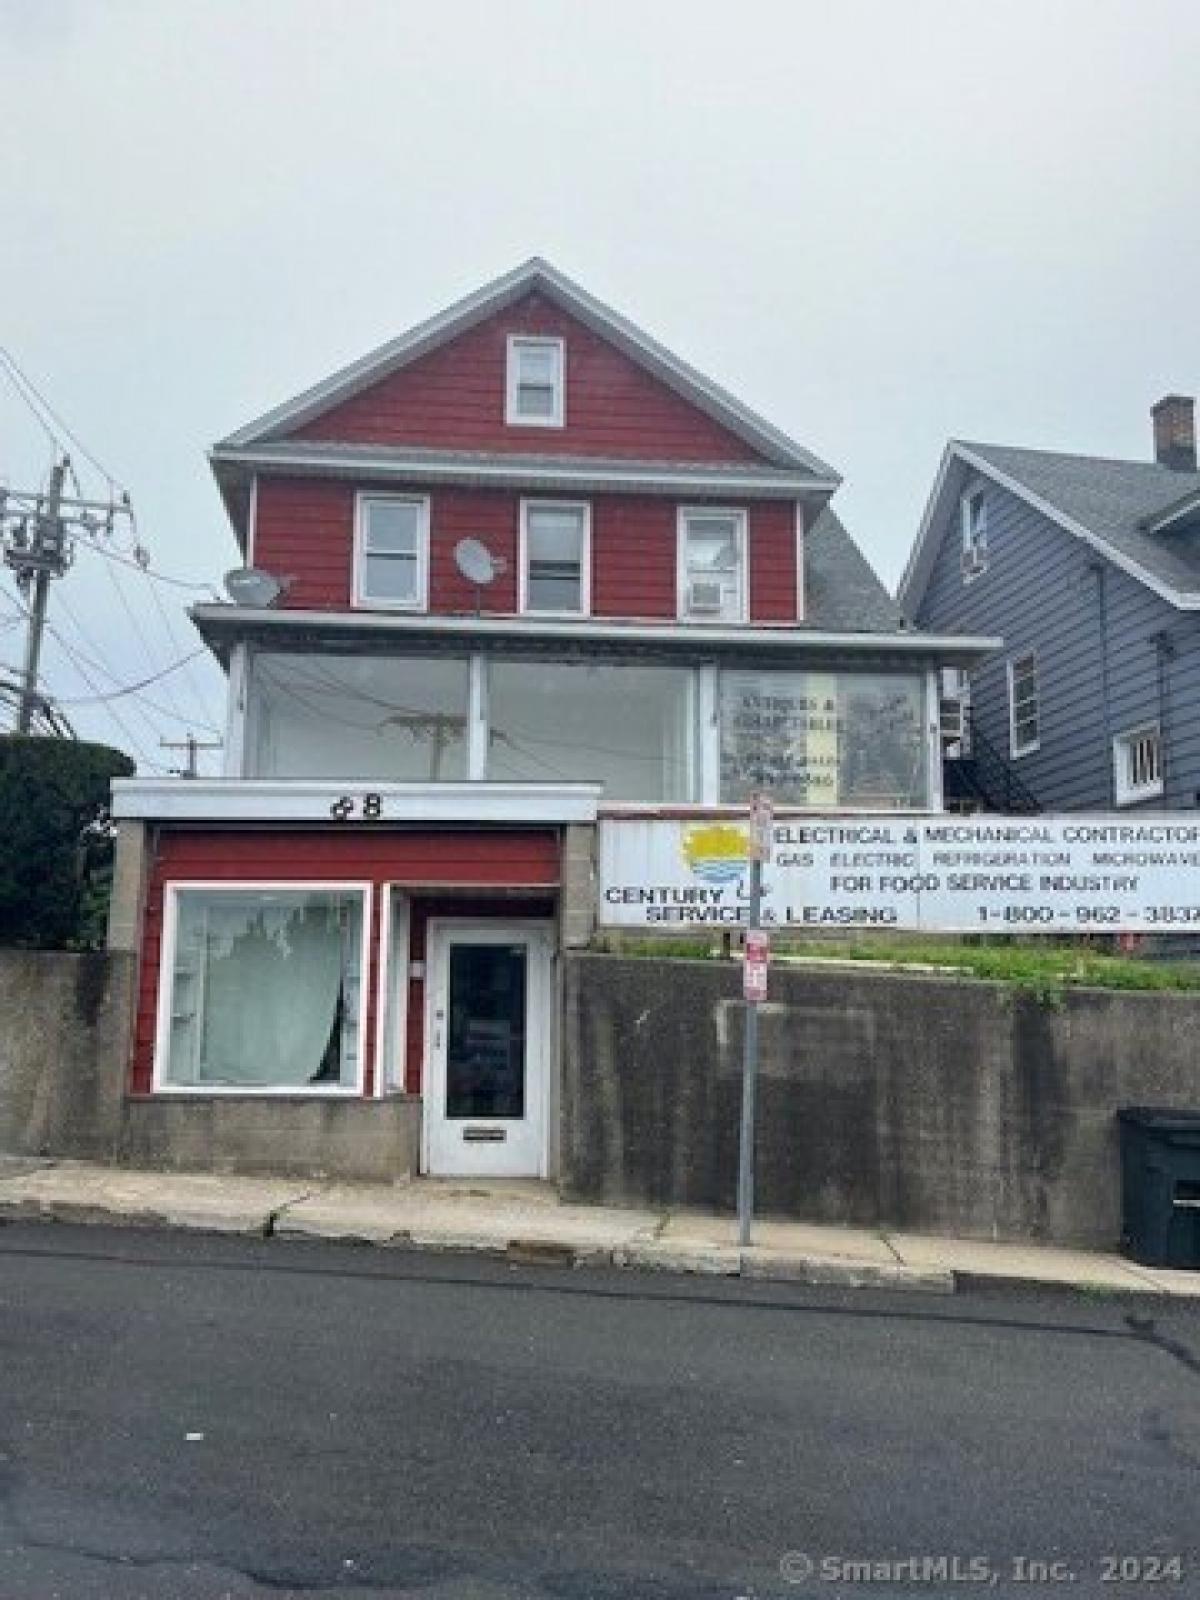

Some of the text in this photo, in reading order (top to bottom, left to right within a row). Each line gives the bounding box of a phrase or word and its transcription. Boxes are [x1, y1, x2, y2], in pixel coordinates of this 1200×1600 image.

[773, 826, 894, 844] ELECTRICAL
[903, 827, 917, 844] &
[925, 826, 1055, 844] MECHANICAL
[776, 852, 814, 868] GAS
[829, 852, 914, 868] ELECTRIC
[933, 852, 1071, 868] REFRIGERATION
[829, 874, 1140, 893] FOR FOOD SERVICE INDUSTRY
[604, 886, 724, 904] CENTURY
[645, 906, 752, 922] SERVICE
[786, 906, 898, 924] LEASING
